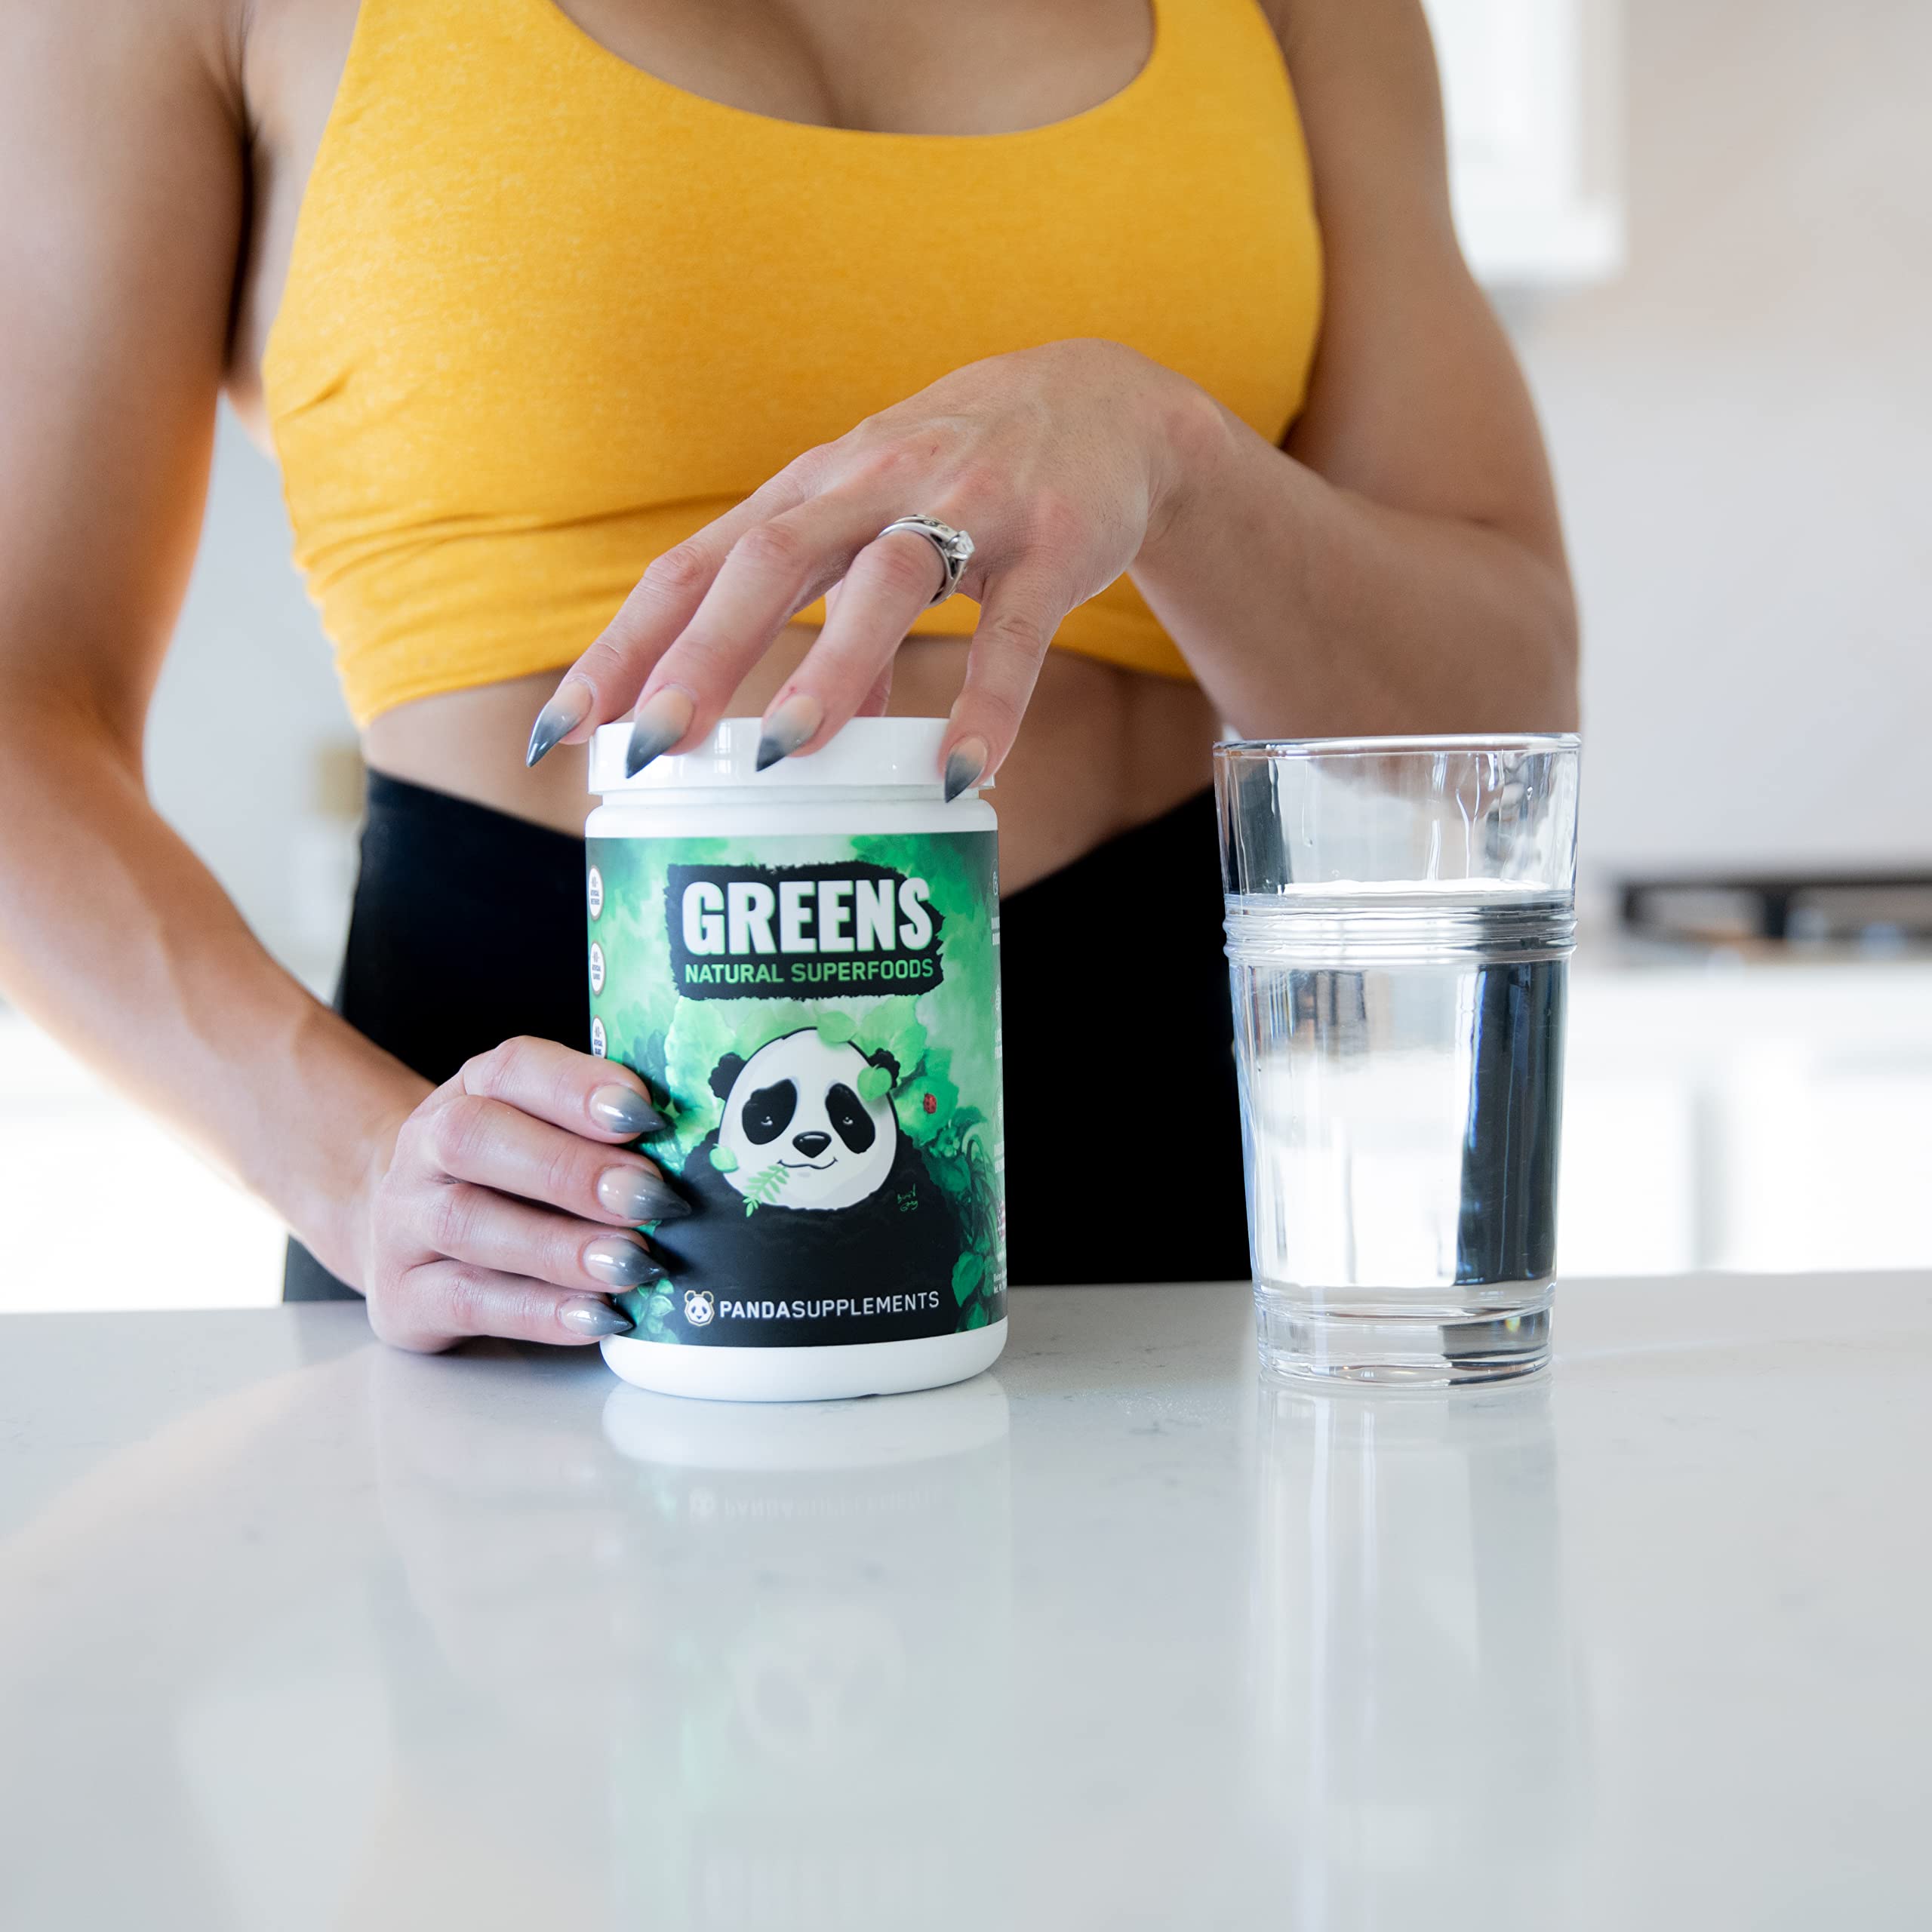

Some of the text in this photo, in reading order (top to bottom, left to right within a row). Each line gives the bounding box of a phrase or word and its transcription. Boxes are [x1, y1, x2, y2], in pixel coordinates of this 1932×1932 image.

[682, 878, 933, 955] GREENS
[685, 959, 934, 983] NATURAL SUPERFOODS
[719, 1291, 940, 1318] PANDASUPPLEMENTS
